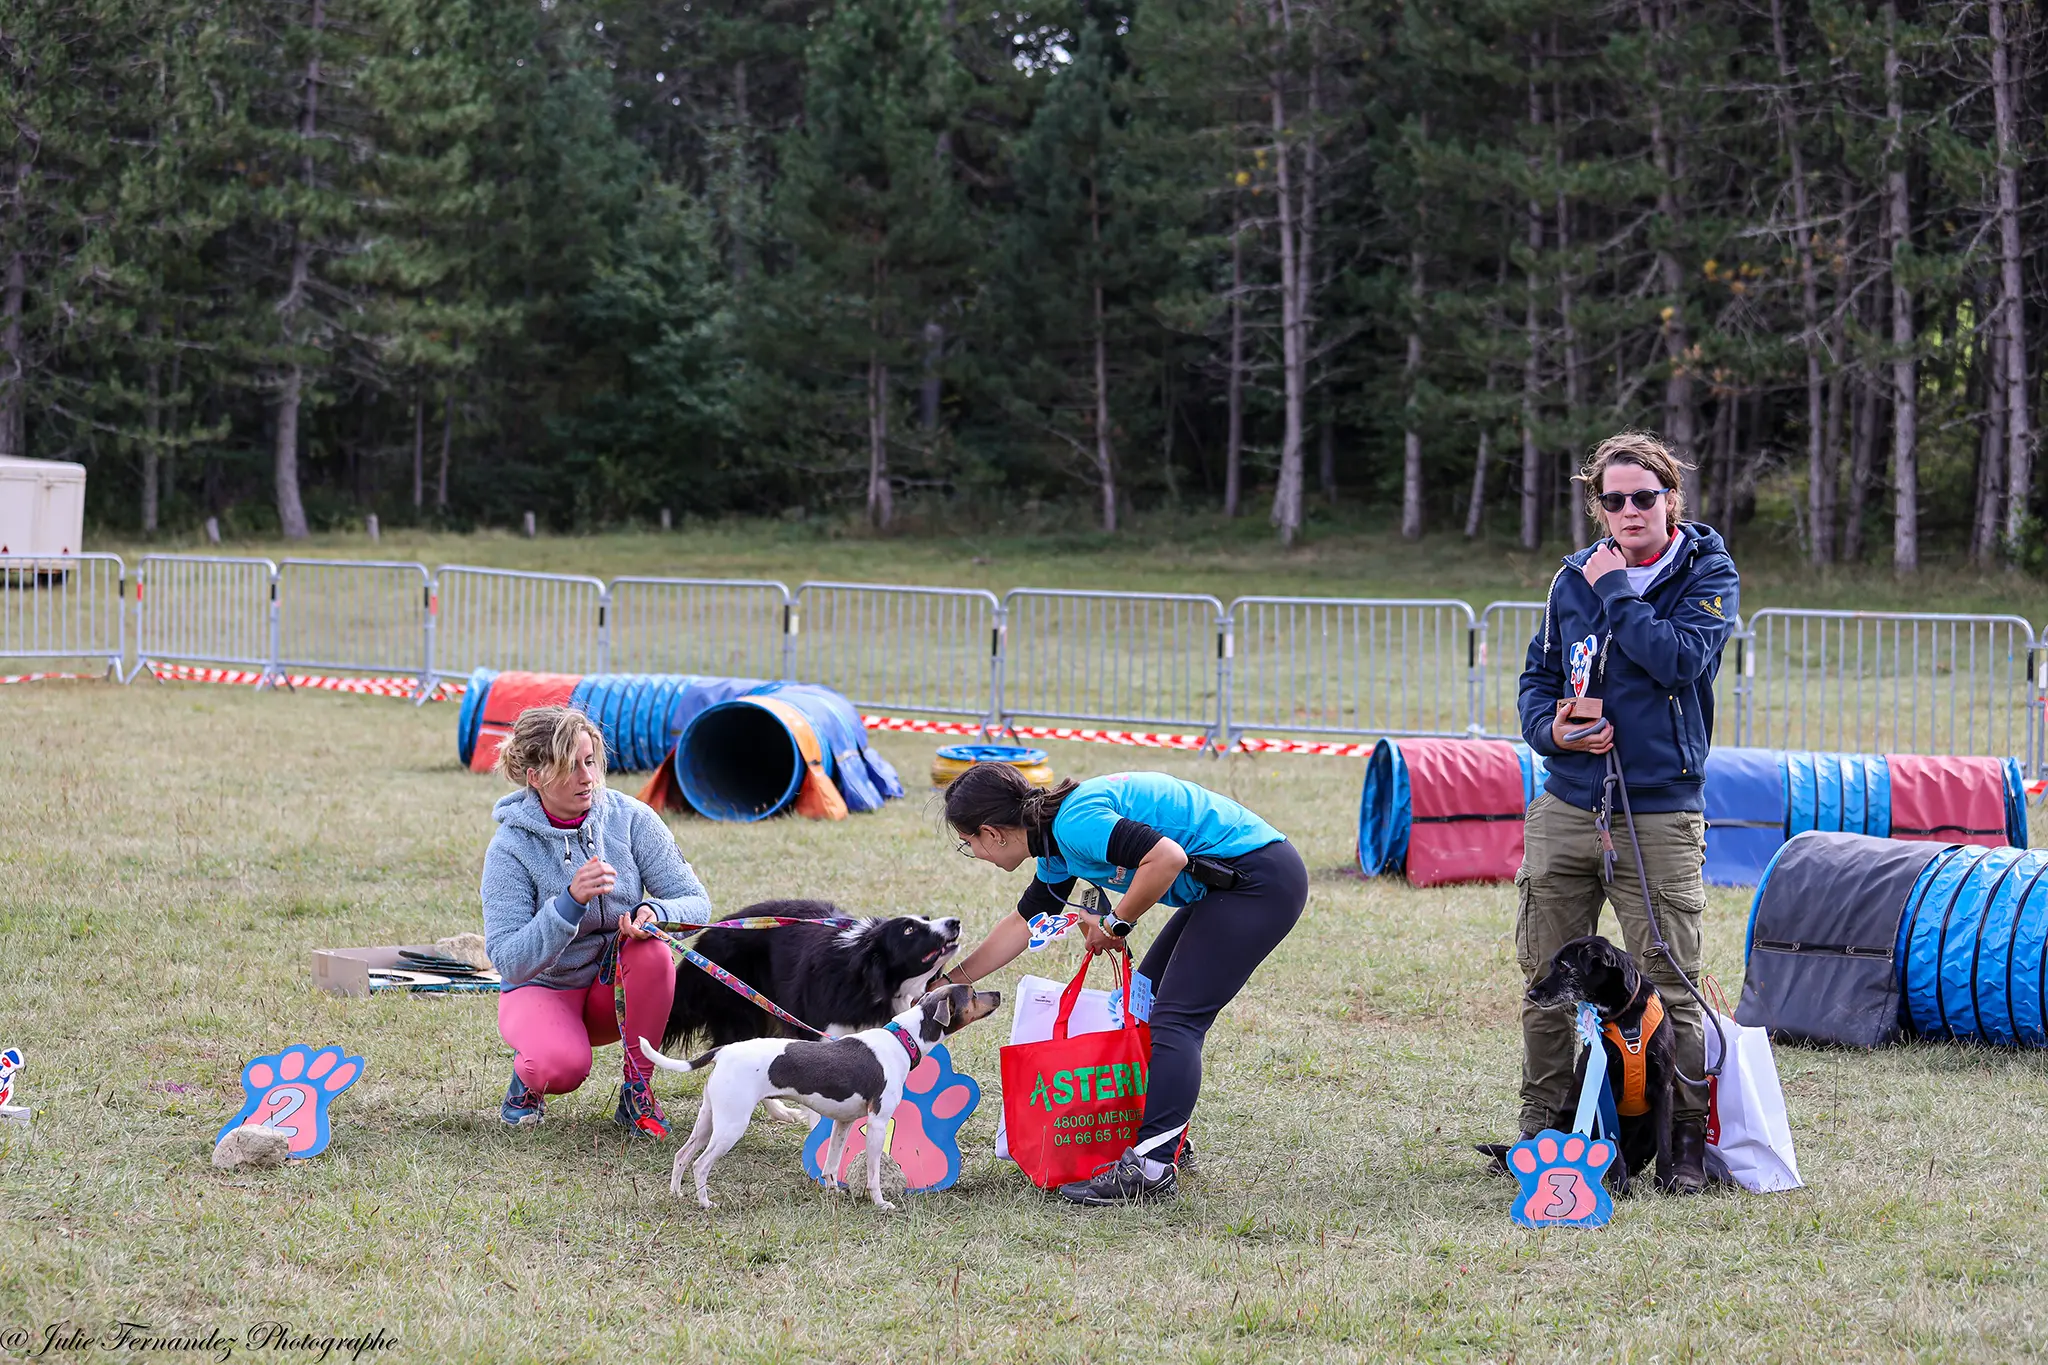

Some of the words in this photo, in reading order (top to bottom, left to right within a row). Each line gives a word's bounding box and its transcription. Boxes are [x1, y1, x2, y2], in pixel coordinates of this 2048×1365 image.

[1029, 1062, 1149, 1112] ASTERI
[262, 1087, 306, 1138] 2
[1053, 1114, 1095, 1129] 48000
[1097, 1108, 1144, 1125] MENDE
[1054, 1134, 1071, 1147] 04
[1075, 1131, 1092, 1145] 66
[1095, 1129, 1112, 1142] 65
[1116, 1127, 1131, 1139] 12
[1544, 1173, 1577, 1218] 3
